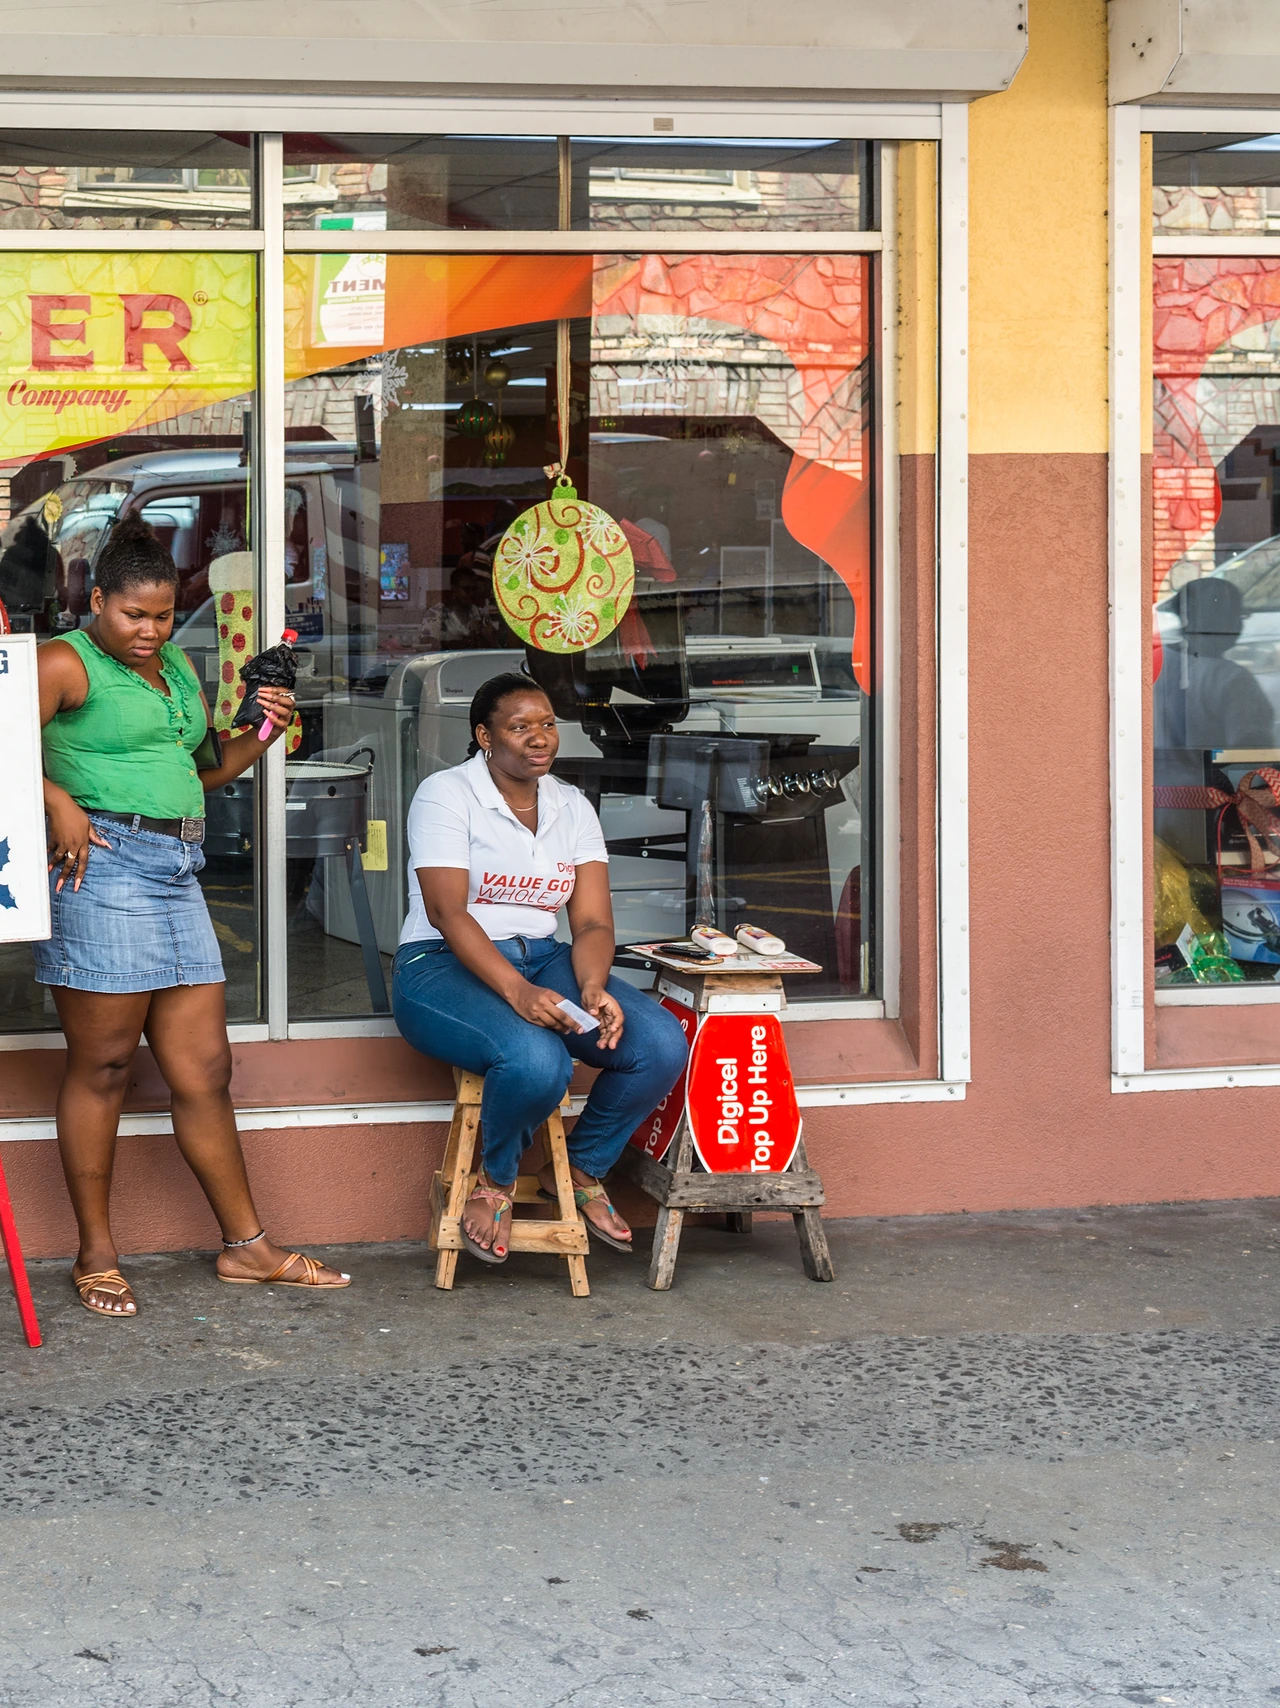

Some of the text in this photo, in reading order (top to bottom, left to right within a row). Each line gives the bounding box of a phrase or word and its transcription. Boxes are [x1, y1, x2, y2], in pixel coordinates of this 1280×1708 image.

[6, 379, 132, 415] Company.
[479, 885, 552, 904] WHOLE
[483, 872, 544, 889] VALUE
[716, 1058, 743, 1144] Digicel
[747, 1025, 775, 1172] Top Up Here
[644, 1116, 662, 1156] Top
